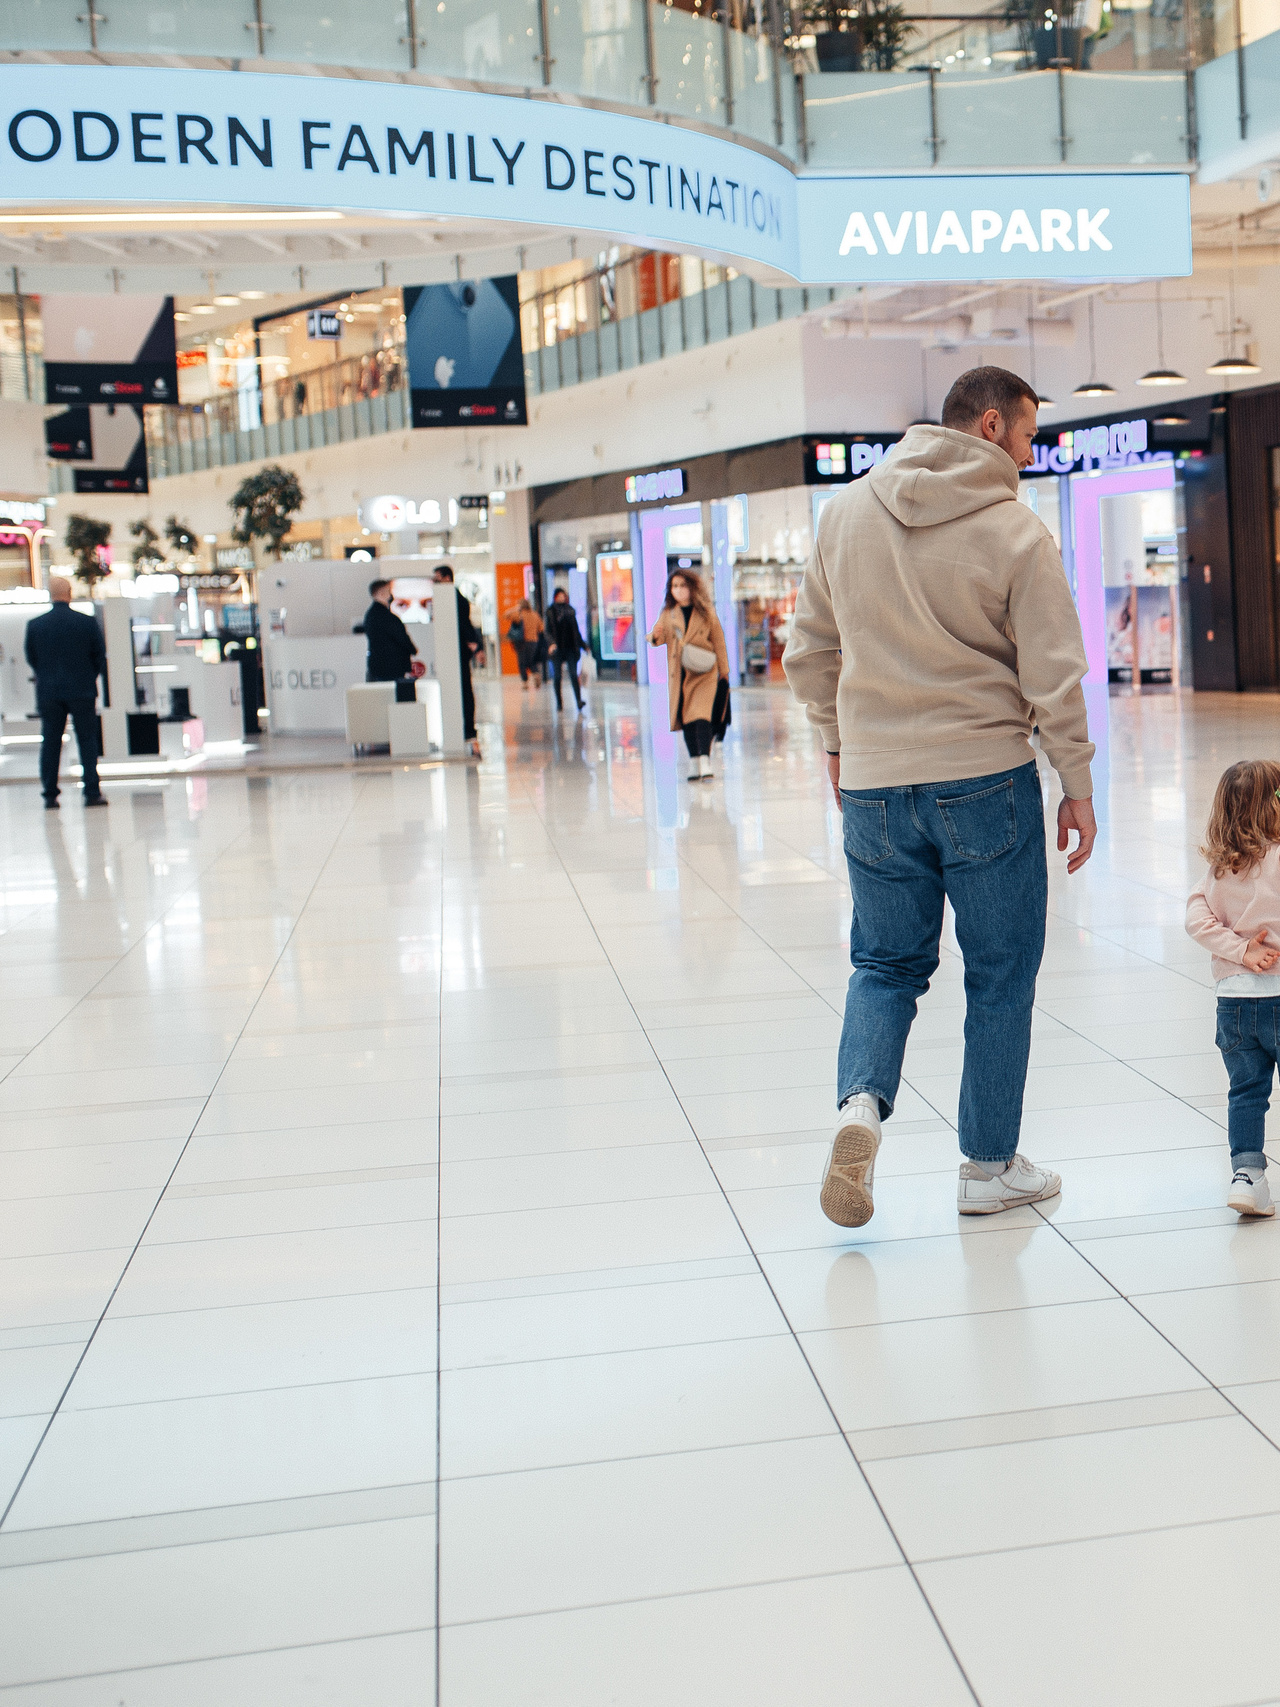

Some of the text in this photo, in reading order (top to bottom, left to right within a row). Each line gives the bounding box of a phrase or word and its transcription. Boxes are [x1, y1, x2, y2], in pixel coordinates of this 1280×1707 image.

[8, 108, 783, 241] ODERN FAMILY DESTINATION
[838, 207, 1113, 256] AVIAPARK
[406, 499, 441, 524] LG
[287, 668, 337, 690] OLED
